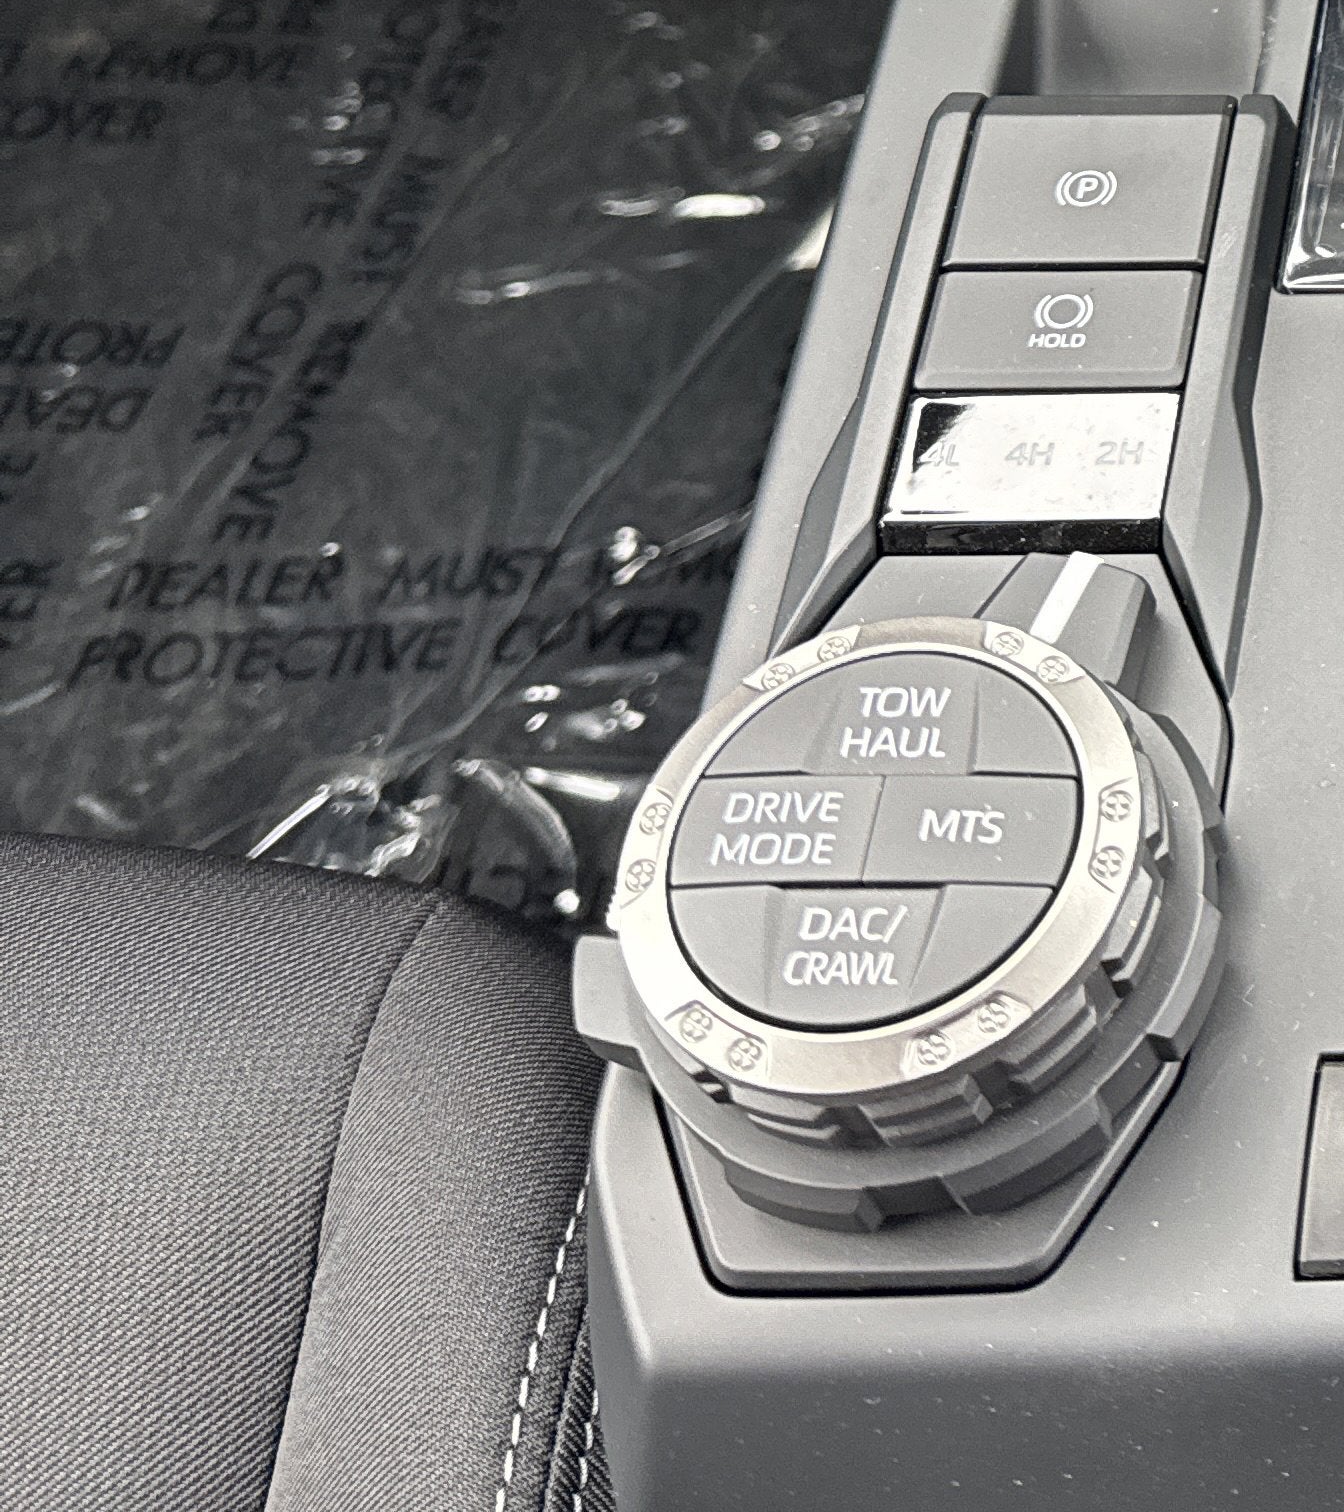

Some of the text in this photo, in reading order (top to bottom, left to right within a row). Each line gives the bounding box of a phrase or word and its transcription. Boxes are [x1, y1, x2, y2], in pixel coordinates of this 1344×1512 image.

[191, 261, 325, 444] COVER
[1027, 332, 1087, 349] HOLD
[1004, 440, 1057, 467] 4H
[1094, 439, 1146, 467] 2H
[104, 549, 347, 612] DEALER
[374, 542, 563, 605] MUST
[64, 604, 705, 692] PROTECTIVE COVER
[858, 686, 952, 718] TOW
[839, 726, 946, 759] HAUL
[722, 791, 844, 825] DRIVE
[918, 807, 1006, 845] MTS
[708, 832, 837, 867] MODE
[798, 904, 909, 943] DAC/
[782, 950, 899, 986] CRAWL
